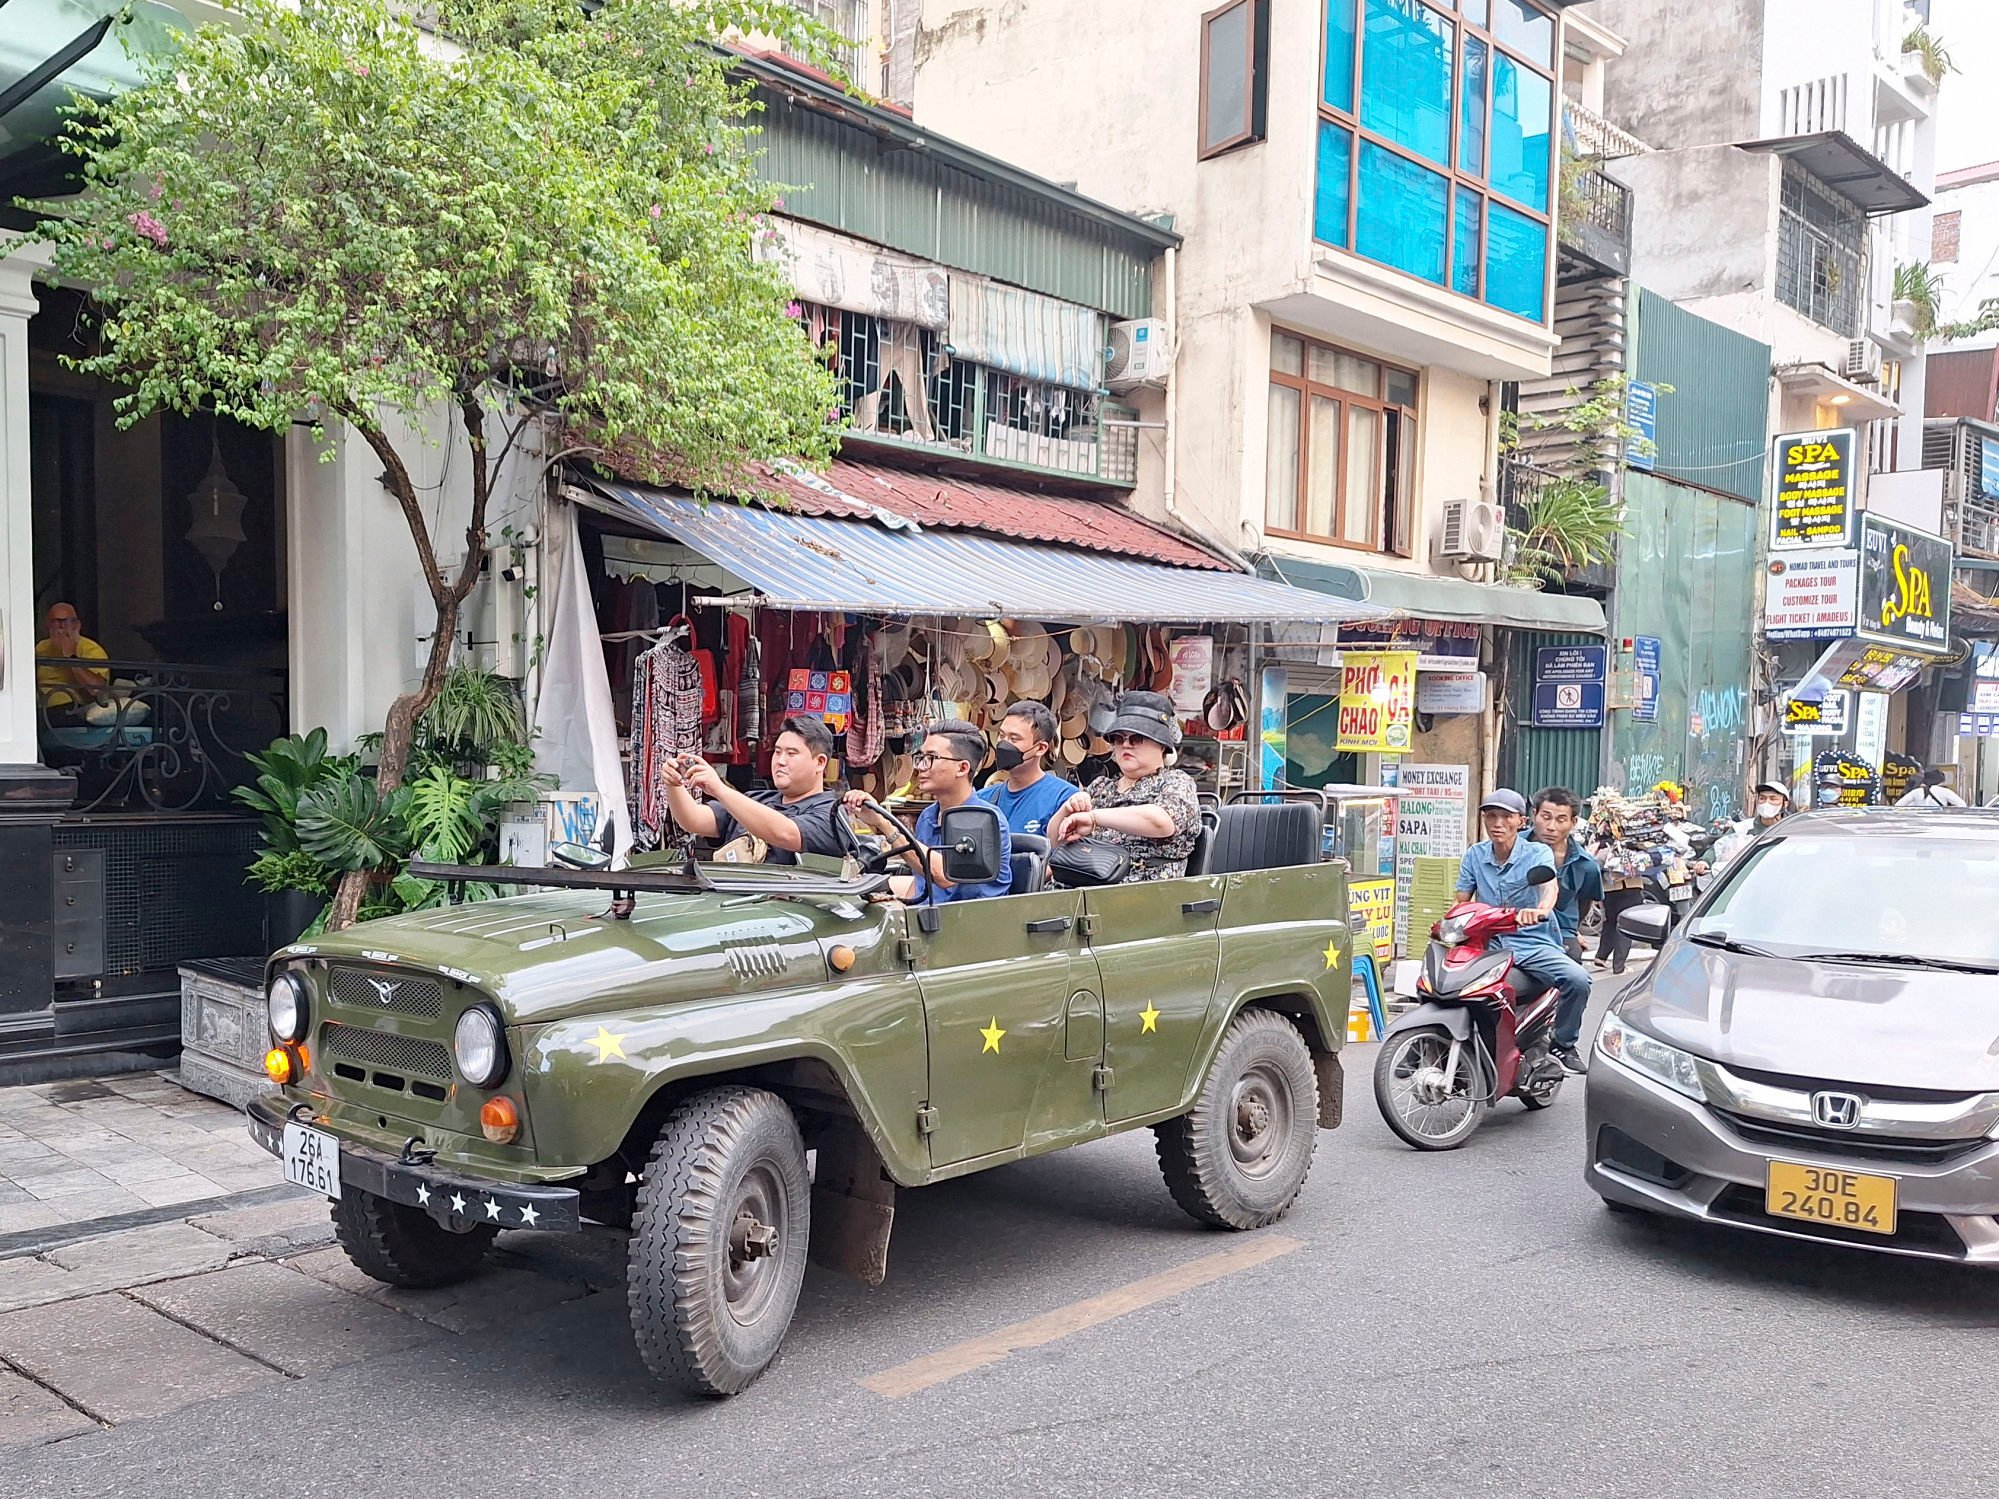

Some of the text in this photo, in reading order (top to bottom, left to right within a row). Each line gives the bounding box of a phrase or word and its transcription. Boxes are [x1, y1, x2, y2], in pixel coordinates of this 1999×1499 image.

[1788, 442, 1840, 465] SPA
[1785, 470, 1839, 483] MASSAGE
[1804, 487, 1845, 499] MASSAGE
[1779, 505, 1843, 518] FOOT MASSAGE
[1780, 528, 1798, 537] NAIL
[1789, 559, 1856, 571] NOMAD TRAVEL AND TOURS
[1785, 576, 1837, 588] PACKAGES TOUR
[1882, 544, 1932, 626] SPA
[1783, 594, 1837, 606] CUSTOMIZE TOUR
[1766, 614, 1787, 624] FLIGHT
[1789, 613, 1810, 623] TICKET
[1817, 612, 1848, 622] AMADEUS
[1425, 620, 1479, 639] OFFICE
[1787, 700, 1820, 722] SPA
[1340, 701, 1379, 736] CHÁO
[1838, 763, 1870, 779] SPA
[1887, 763, 1917, 776] Spa
[1403, 771, 1462, 785] MONEY EXCHANGE
[1401, 801, 1432, 814] HALONG
[1400, 820, 1428, 835] SAPA
[1399, 840, 1427, 854] MAI CHAU
[1376, 905, 1390, 920] LU
[300, 1131, 323, 1161] 26A
[291, 1156, 333, 1194] 176.61
[1804, 1169, 1858, 1198] 30E
[1781, 1191, 1879, 1227] 240.84
